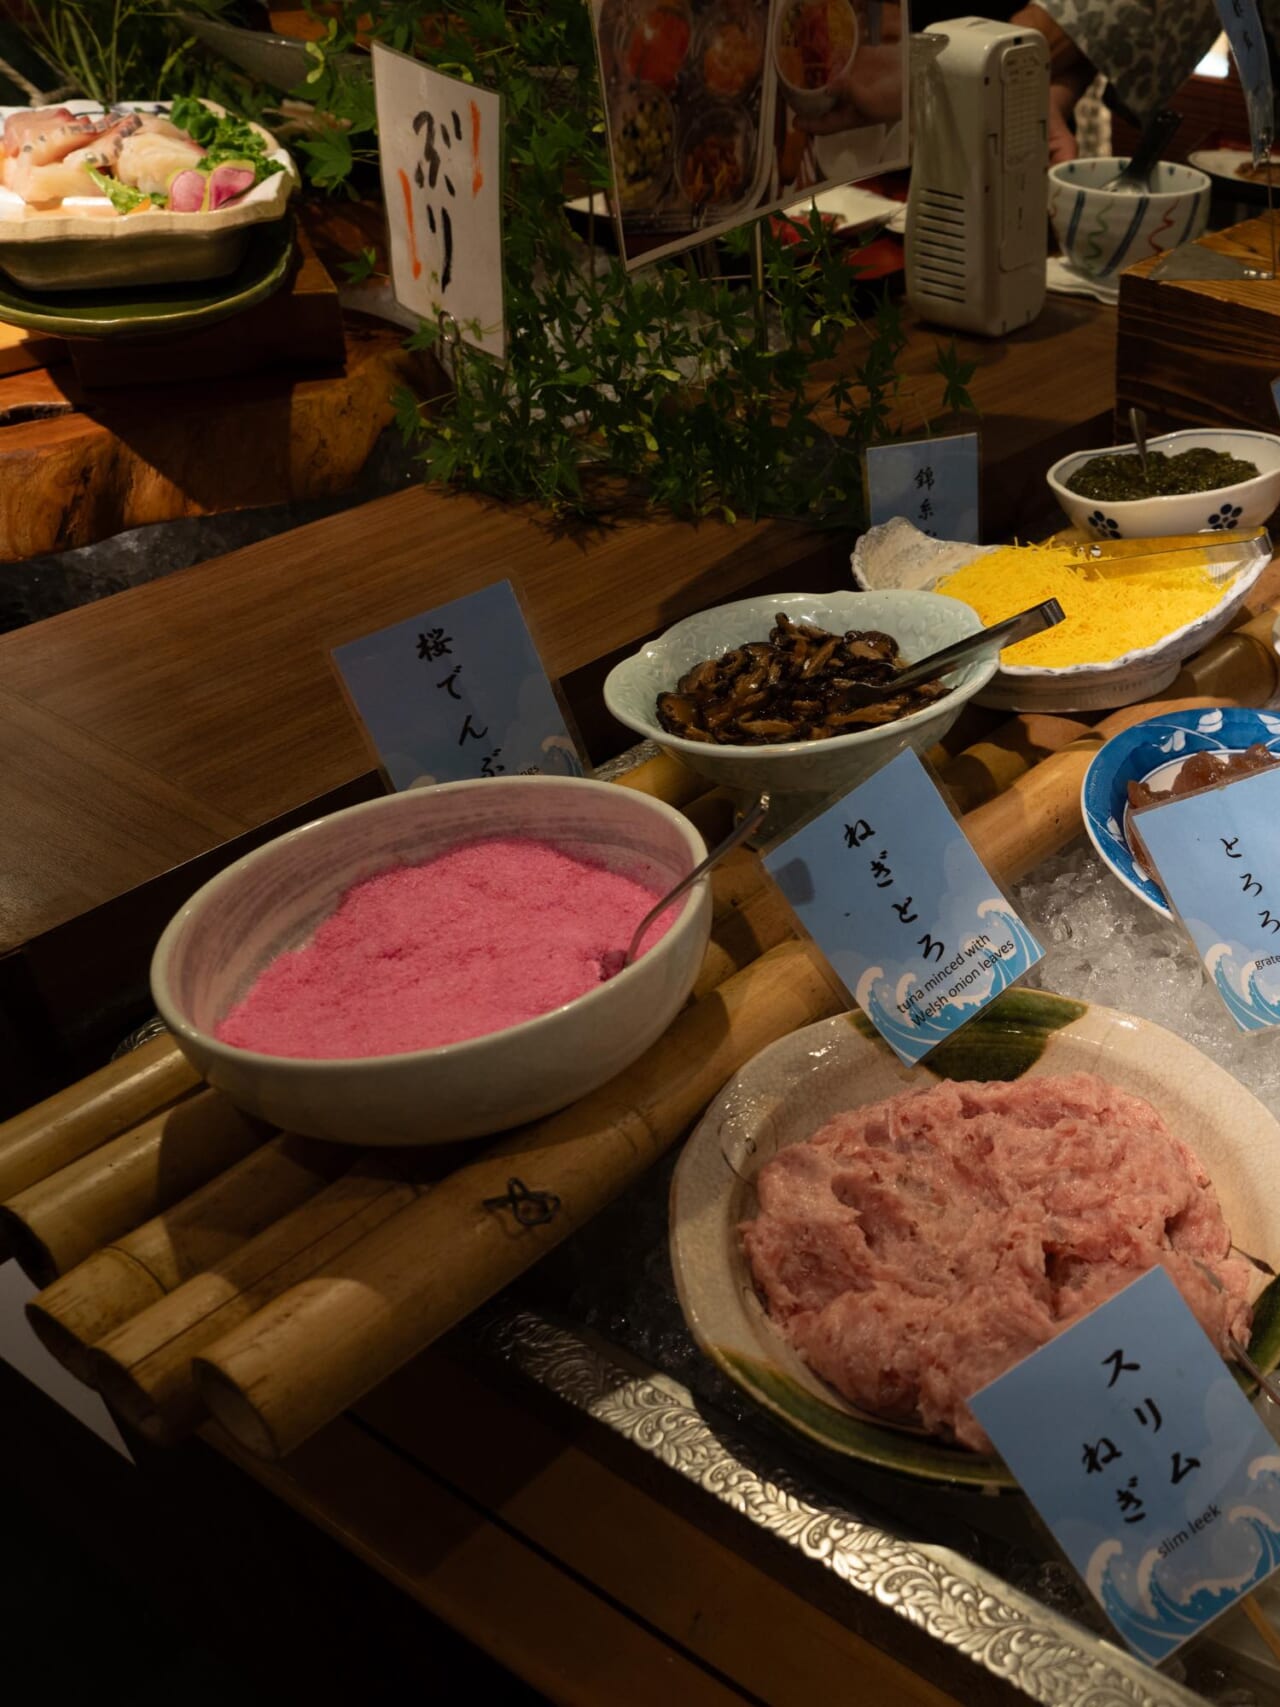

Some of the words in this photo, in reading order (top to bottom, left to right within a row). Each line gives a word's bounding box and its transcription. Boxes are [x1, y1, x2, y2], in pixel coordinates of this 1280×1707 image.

[412, 110, 462, 293] ぶり
[914, 466, 937, 537] 錦糸
[844, 819, 945, 962] ねぎとろ
[1220, 837, 1280, 934] とろろ
[897, 990, 924, 1014] tuna
[925, 953, 965, 992] minced
[965, 934, 991, 958] with
[911, 995, 948, 1026] Welsh
[948, 968, 981, 998] onion
[978, 940, 1014, 971] leaves
[1102, 1349, 1201, 1485] スリム
[1081, 1437, 1146, 1524] ねぎ
[1157, 1530, 1190, 1559] slim
[1188, 1503, 1222, 1536] leek
